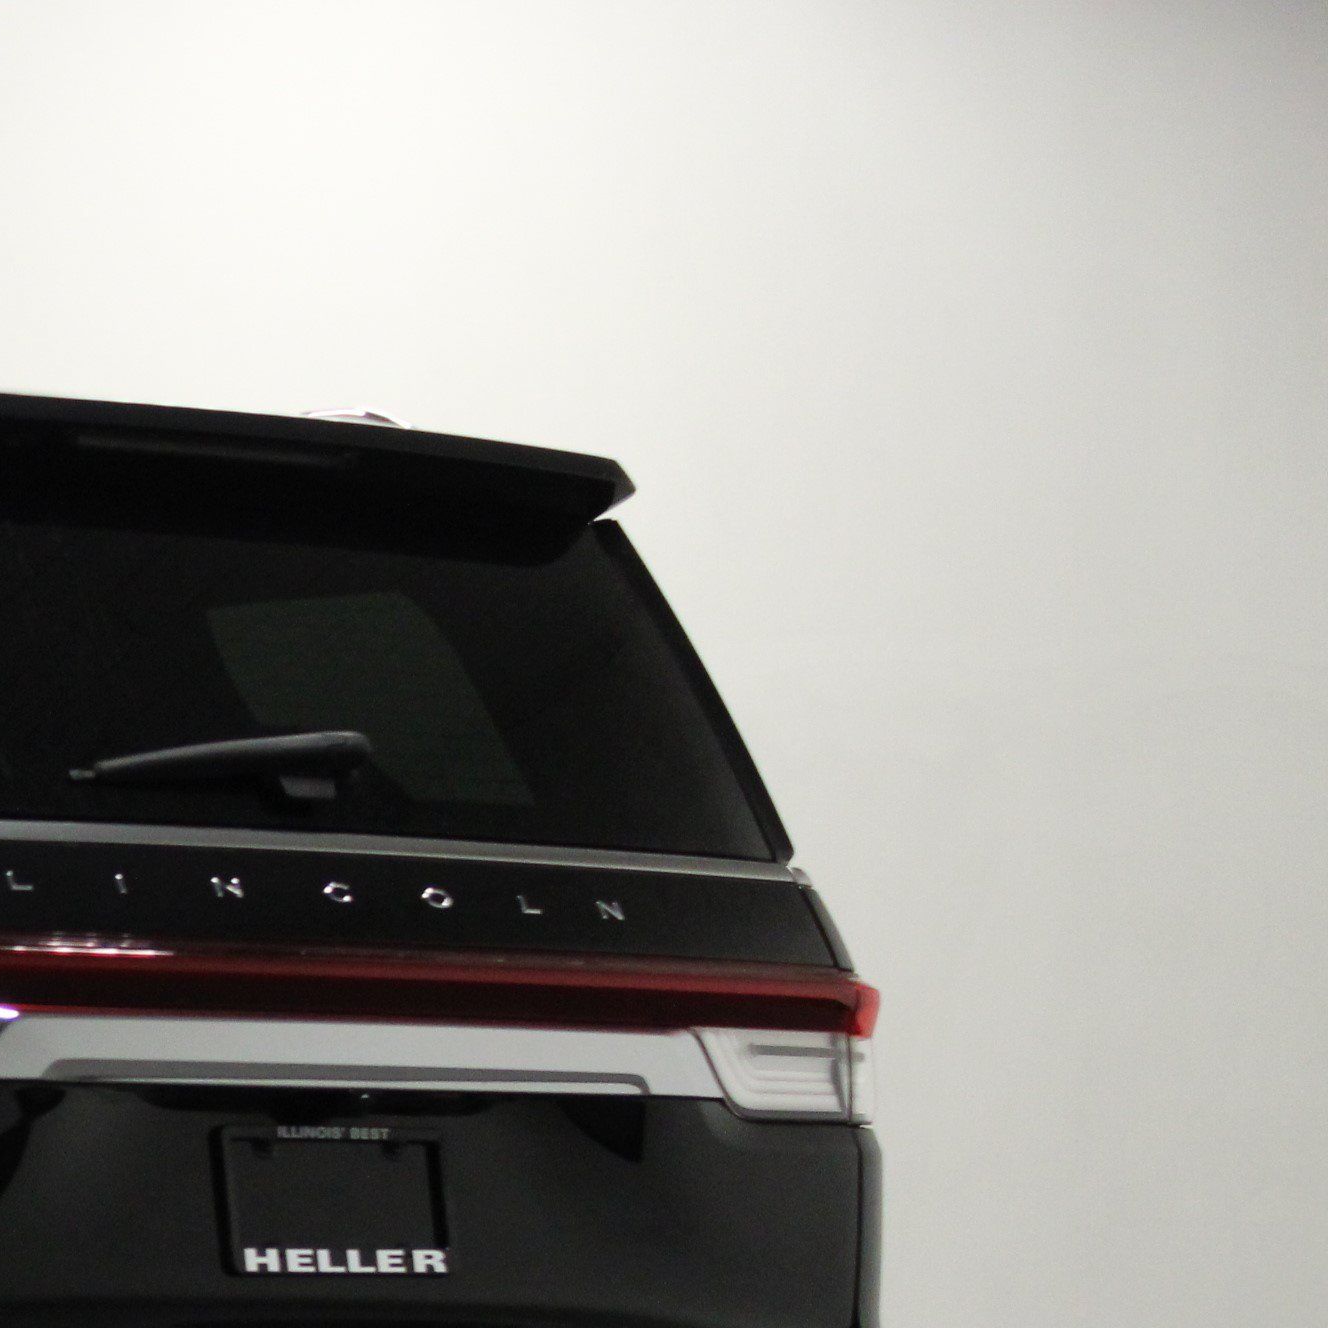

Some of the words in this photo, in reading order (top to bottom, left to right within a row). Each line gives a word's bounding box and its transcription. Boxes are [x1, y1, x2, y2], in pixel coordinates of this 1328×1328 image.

[5, 868, 626, 922] LINCOLN
[349, 1126, 390, 1140] BEST
[243, 1247, 448, 1273] HELLER
